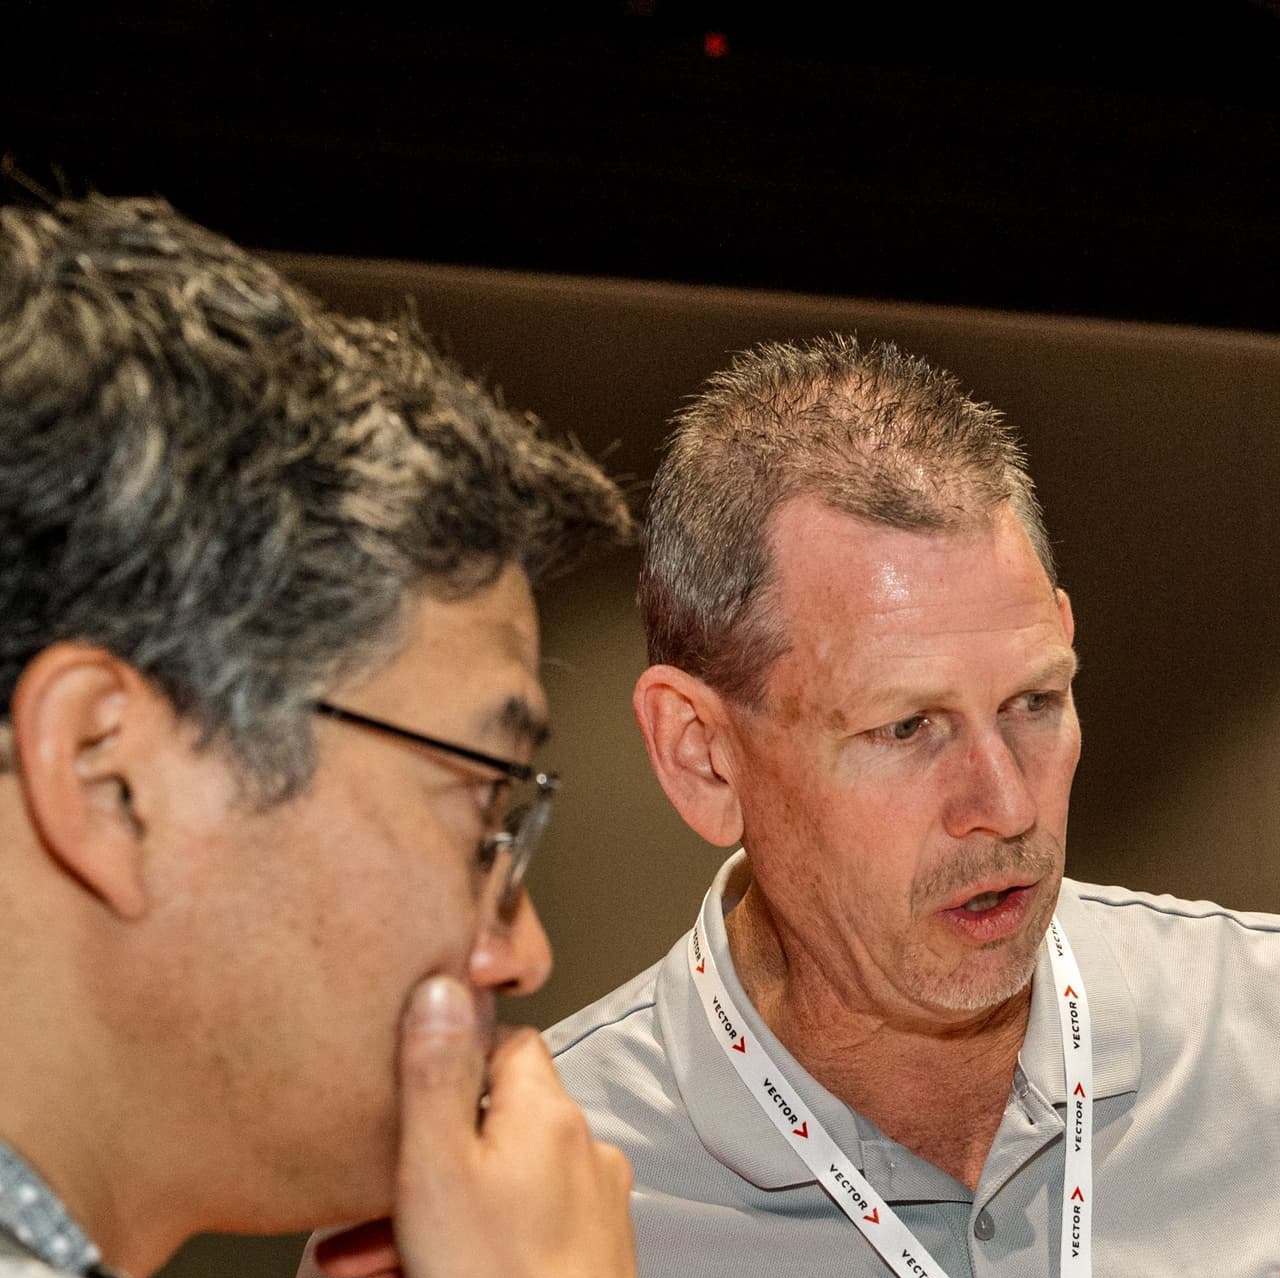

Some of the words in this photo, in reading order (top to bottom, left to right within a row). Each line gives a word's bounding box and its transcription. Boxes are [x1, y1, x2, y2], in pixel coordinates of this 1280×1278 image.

[1051, 920, 1064, 957] VECTO
[712, 995, 738, 1041] VECTOR
[1069, 1001, 1081, 1050] VECTOR
[763, 1077, 799, 1126] VECTOR
[1073, 1100, 1085, 1153] VECTOR
[828, 1163, 870, 1212] VECTOR
[1071, 1204, 1083, 1259] VECTOR
